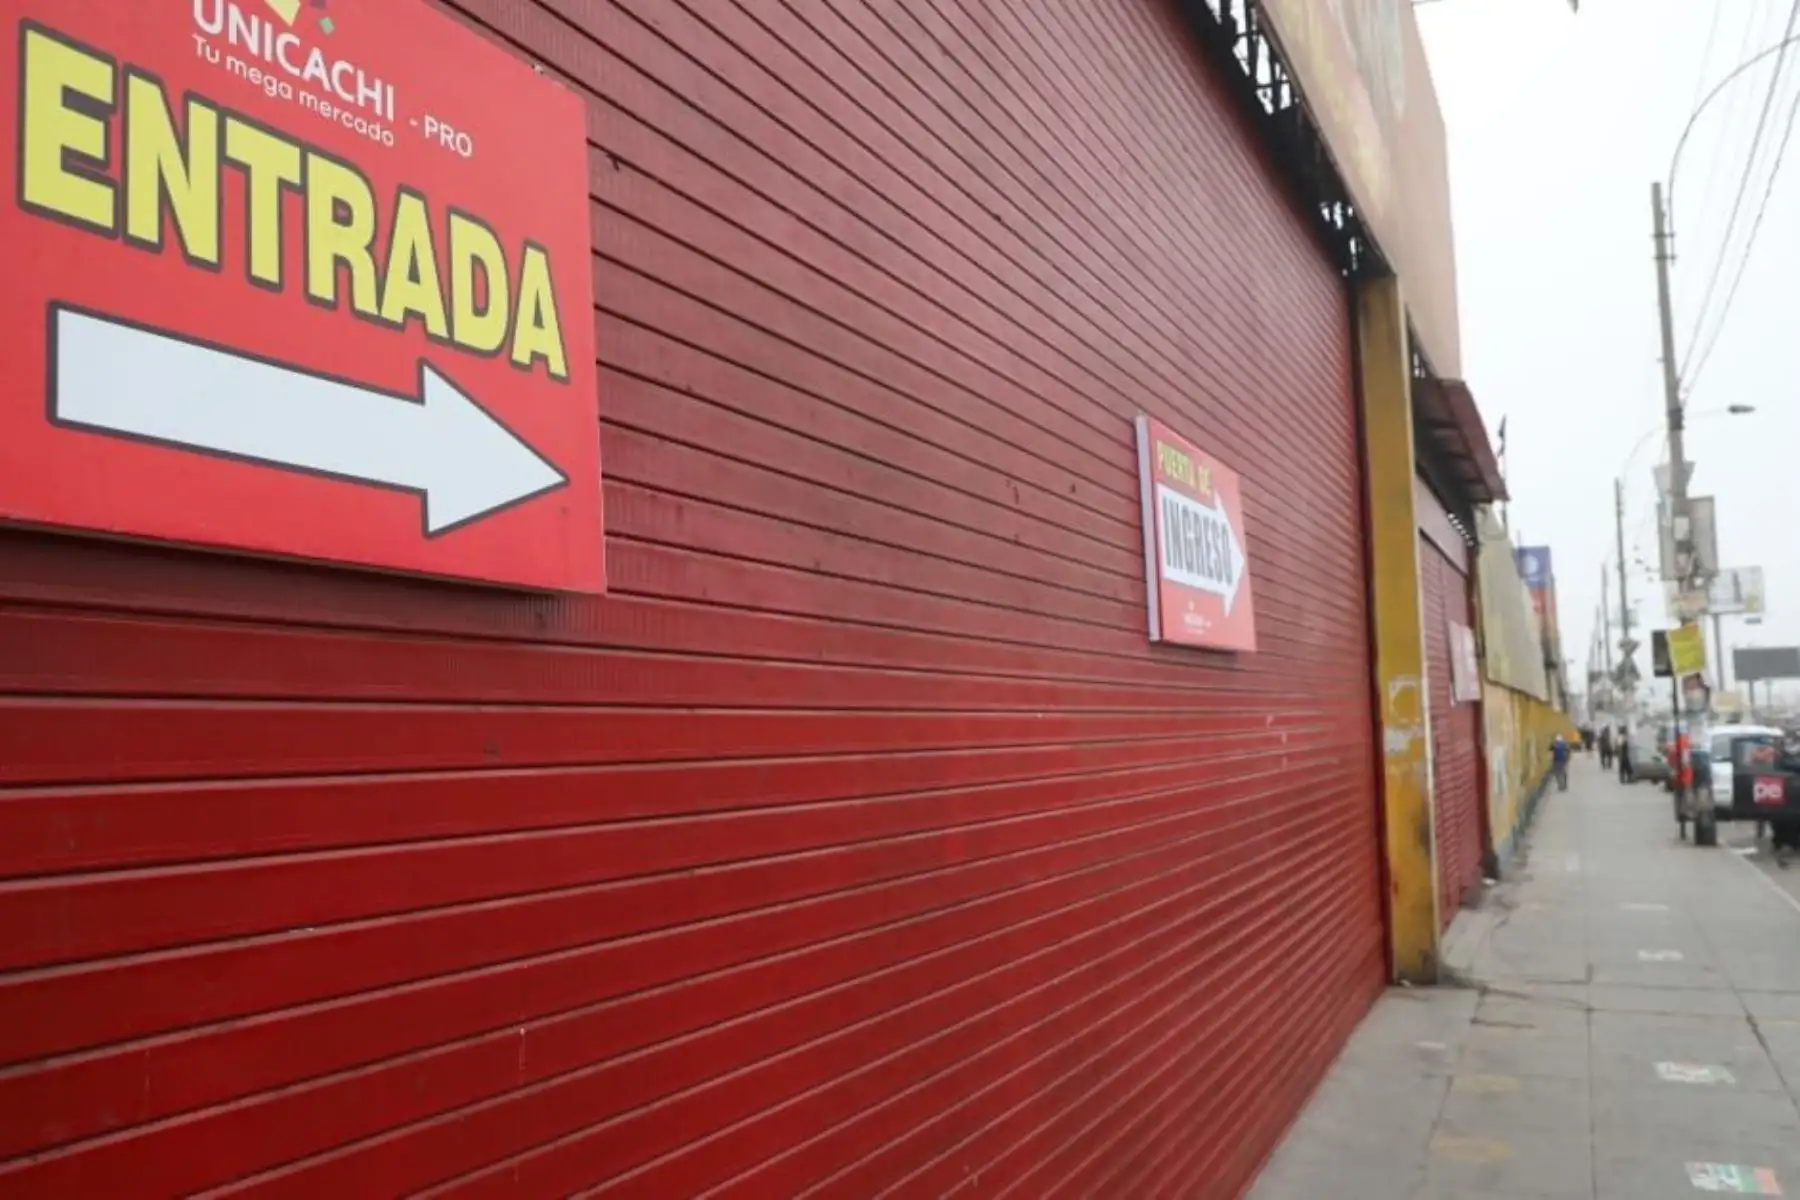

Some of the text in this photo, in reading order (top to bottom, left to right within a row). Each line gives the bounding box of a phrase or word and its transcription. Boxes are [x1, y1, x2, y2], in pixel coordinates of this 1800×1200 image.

[192, 33, 395, 147] Tu mega mercado
[193, 0, 395, 121] UNICACHI
[20, 22, 569, 382] ENTRADA
[1162, 495, 1233, 587] INGRESO
